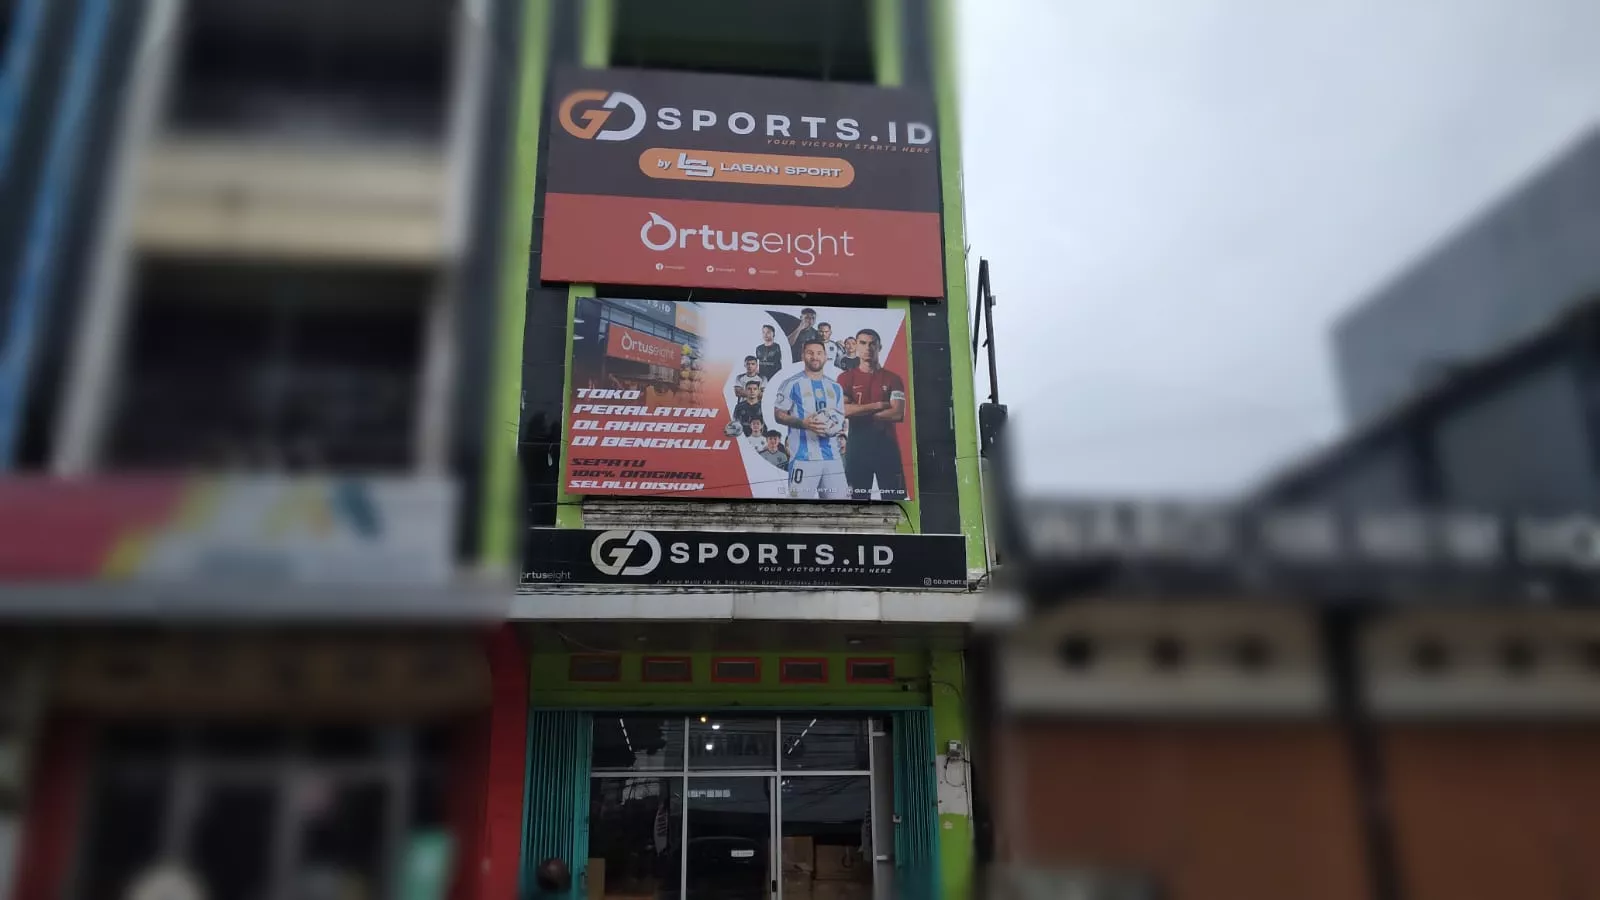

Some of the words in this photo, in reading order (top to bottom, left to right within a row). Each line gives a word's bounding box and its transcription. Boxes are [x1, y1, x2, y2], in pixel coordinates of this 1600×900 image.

[656, 106, 933, 145] SPORTS.ID
[766, 138, 796, 146] YOUR
[801, 141, 850, 149] VICTORY
[855, 144, 897, 152] STARTS
[902, 146, 931, 154] HERE
[657, 158, 671, 170] by
[720, 162, 779, 174] LABAN
[784, 166, 843, 178] SPORT
[576, 388, 641, 400] TOKO
[573, 404, 719, 418] PERALATAN
[572, 419, 705, 433] OLAHRAGA
[571, 436, 598, 446] DI
[600, 436, 731, 450] BENGKULU
[571, 458, 646, 467] SEPATU
[571, 469, 615, 478] 100%
[620, 471, 704, 480] ORIGINAL
[569, 480, 637, 490] SELALU
[639, 481, 704, 491] DISKON
[670, 542, 894, 565] SPORTS.ID
